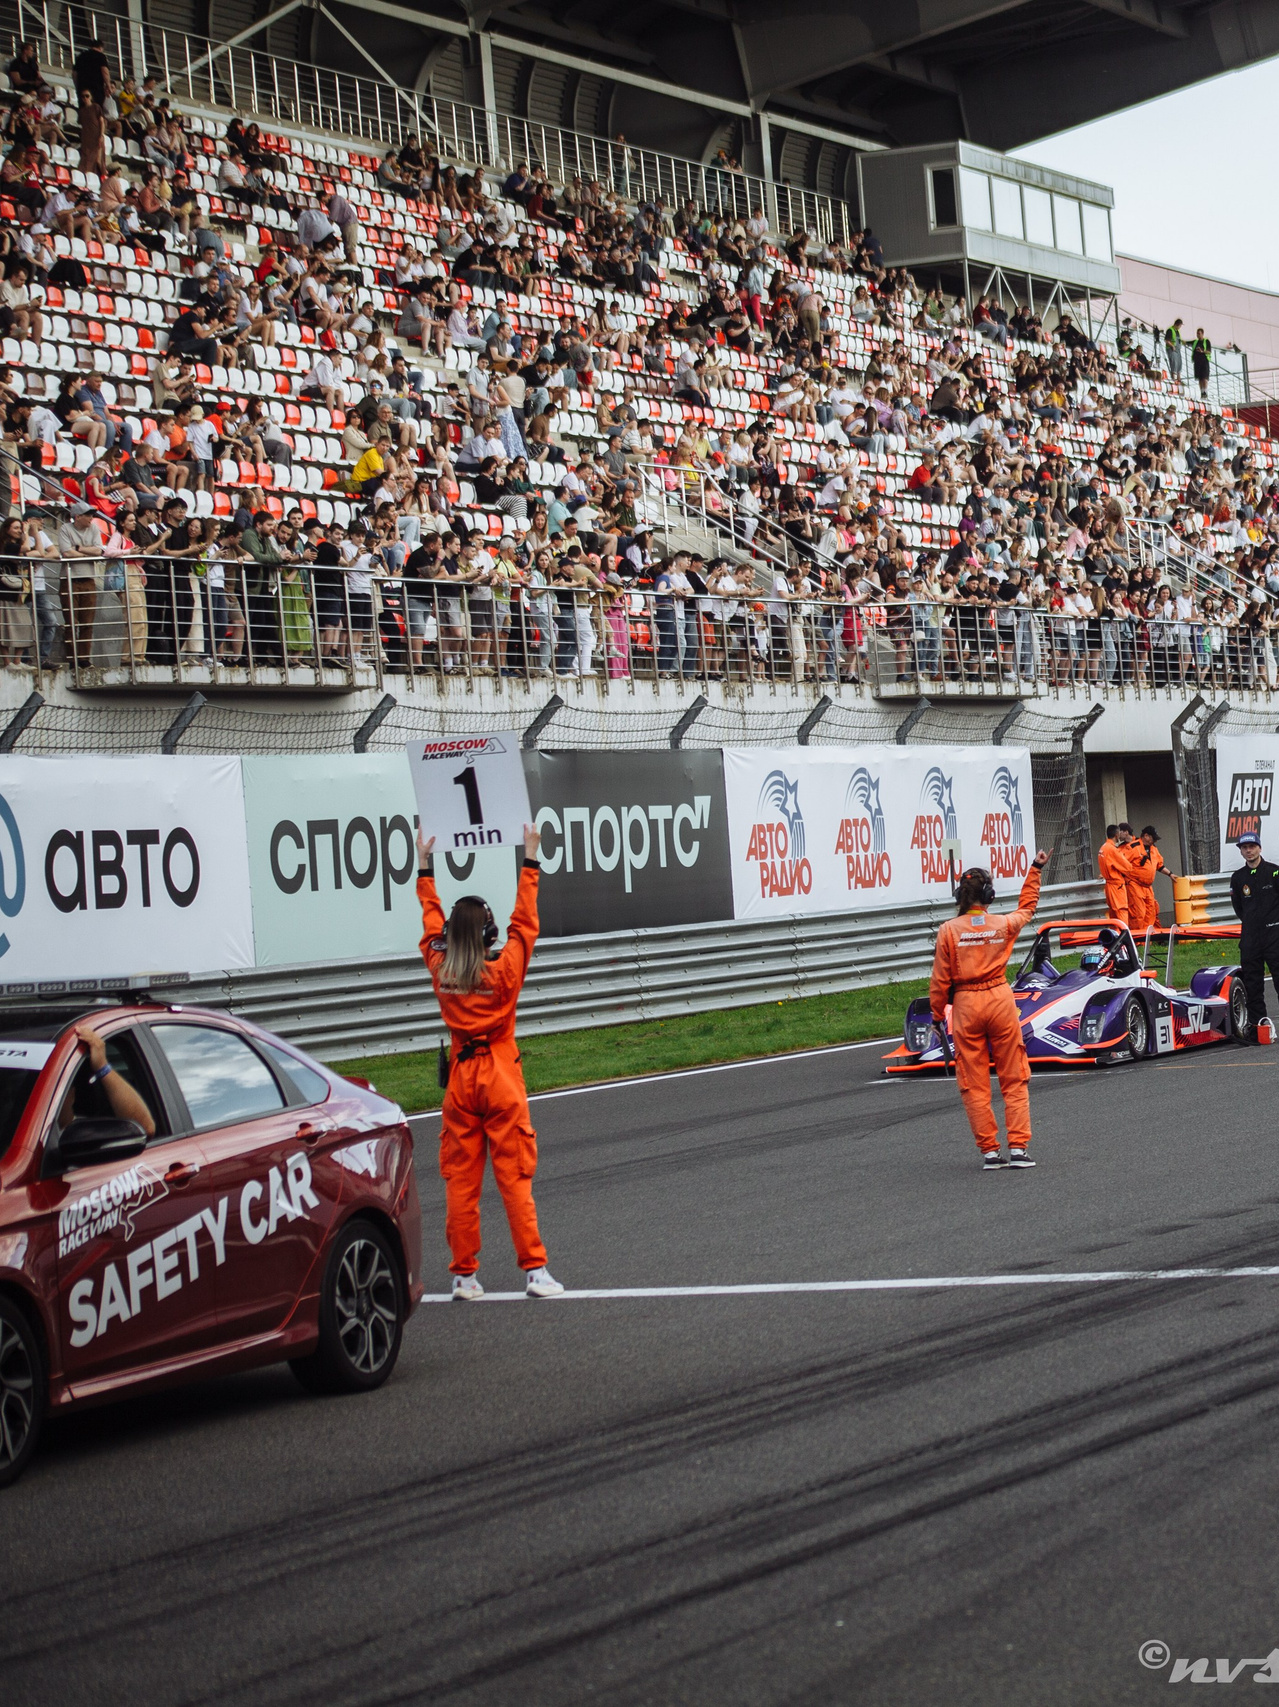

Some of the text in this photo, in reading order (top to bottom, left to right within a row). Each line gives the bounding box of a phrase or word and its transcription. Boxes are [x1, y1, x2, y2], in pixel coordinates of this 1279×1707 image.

[422, 751, 464, 761] RACEWAY
[424, 738, 488, 753] MOSCOW
[453, 767, 484, 825] 1
[1230, 778, 1272, 812] АВТО
[453, 826, 502, 847] min
[746, 822, 788, 861] АВТО
[834, 817, 871, 854] АВТО
[910, 814, 944, 850] АВТО
[980, 812, 1011, 846] АВТО
[44, 827, 200, 913] авто
[759, 857, 812, 898] РАДИО
[846, 852, 892, 890] РАДИО
[990, 844, 1028, 879] РАДИО
[961, 930, 997, 939] MOSCOW
[1160, 1024, 1170, 1045] 31
[58, 1163, 141, 1239] MOSCOW
[58, 1211, 120, 1259] RACEWAY
[70, 1151, 321, 1348] SAFETY CAR
